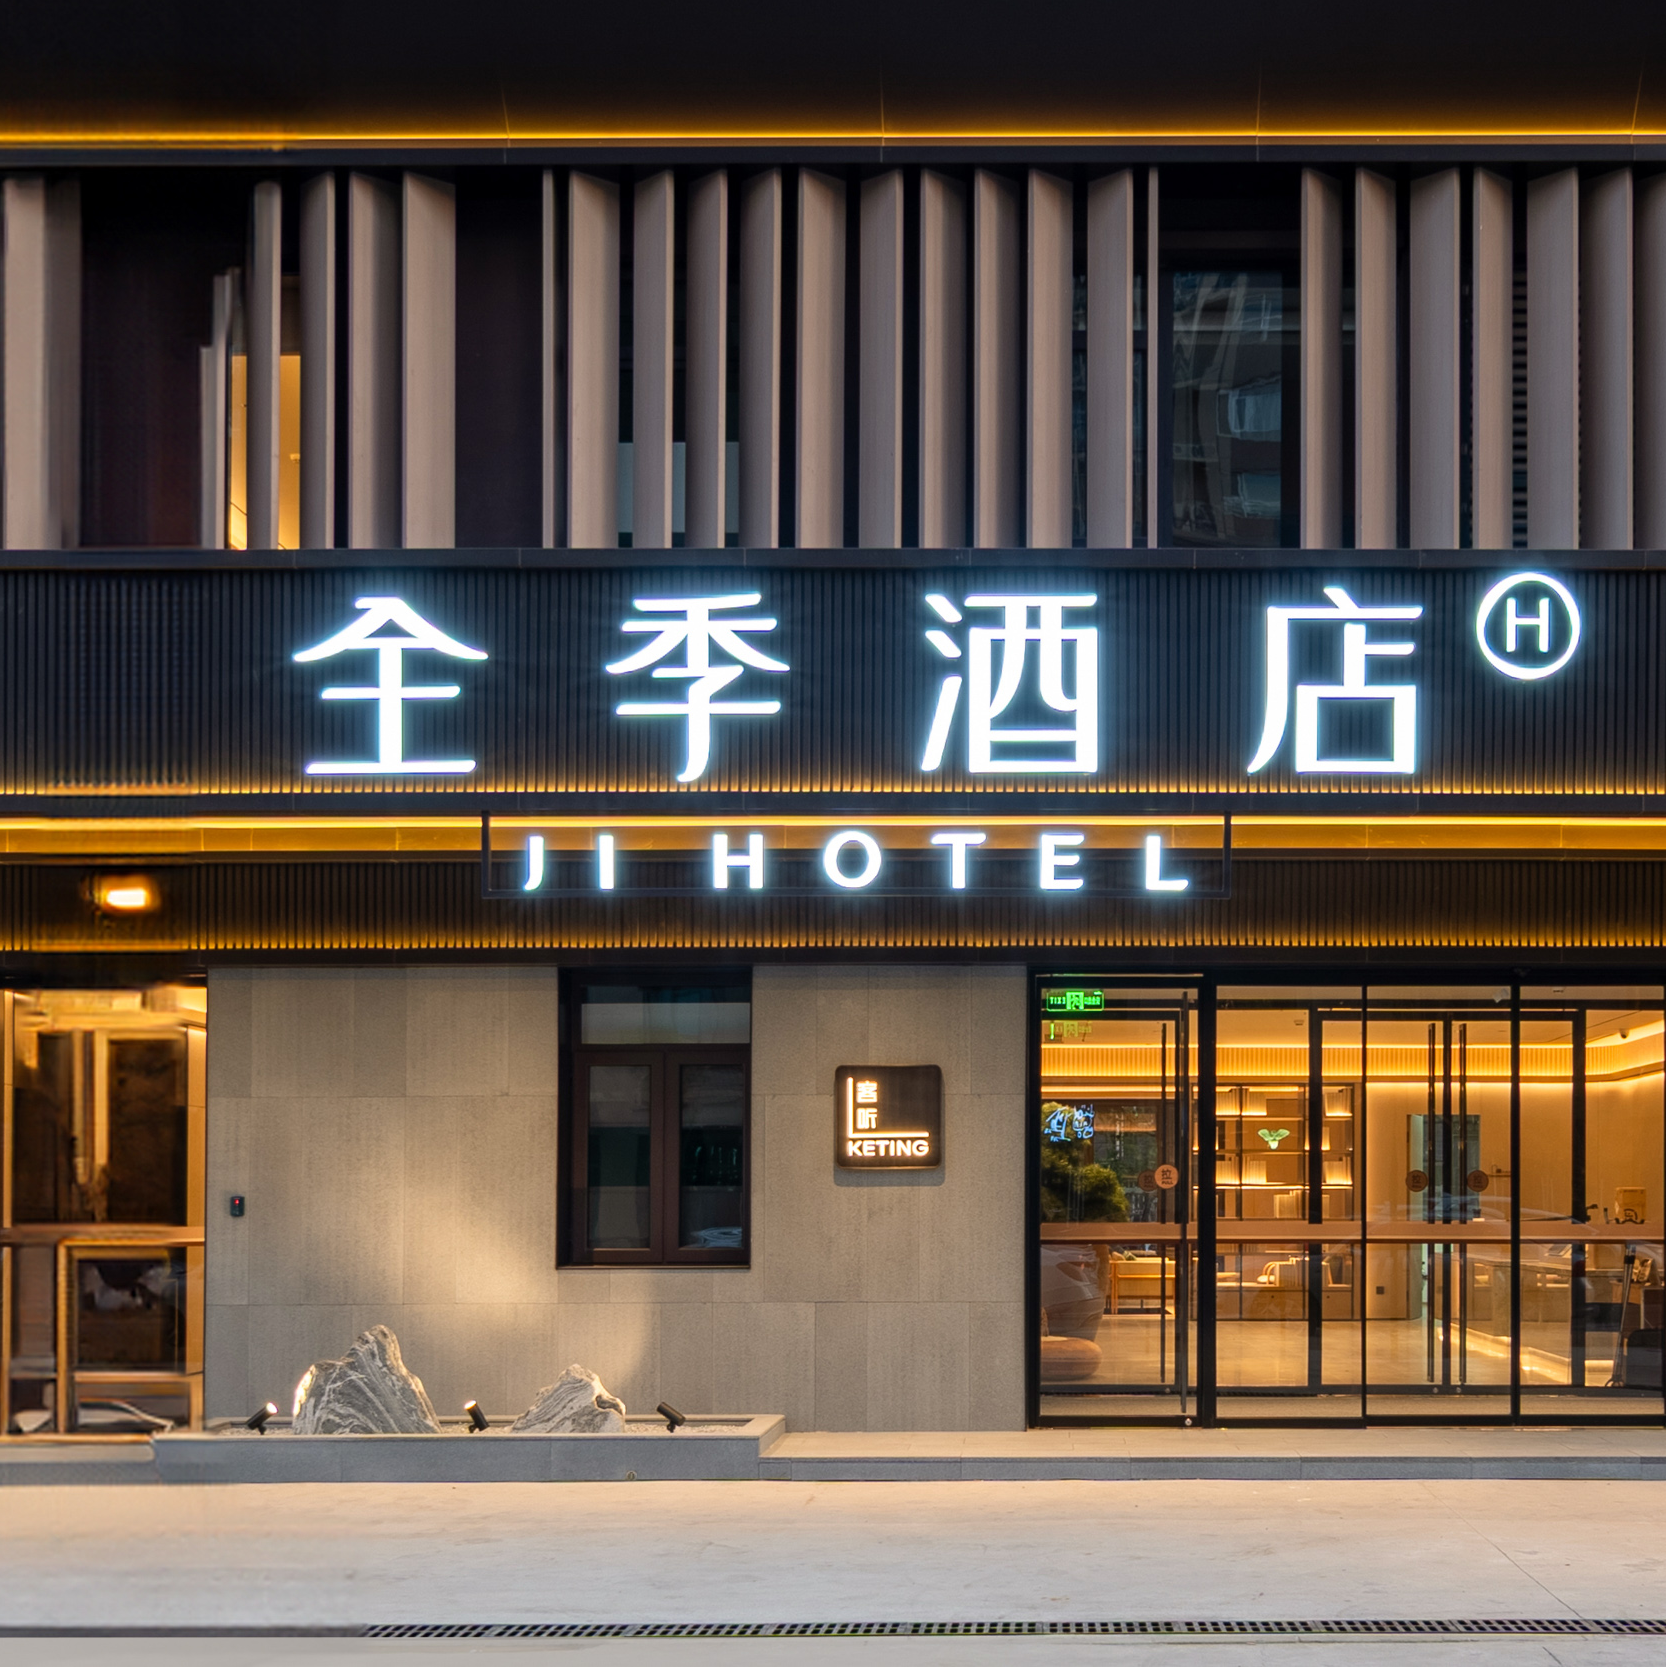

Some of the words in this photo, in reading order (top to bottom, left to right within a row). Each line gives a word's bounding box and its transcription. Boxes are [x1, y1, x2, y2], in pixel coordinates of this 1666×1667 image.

[292, 585, 1424, 783] 全季酒店
[522, 834, 615, 892] JI
[711, 830, 1190, 892] HOTEL
[847, 1139, 930, 1157] KETING
